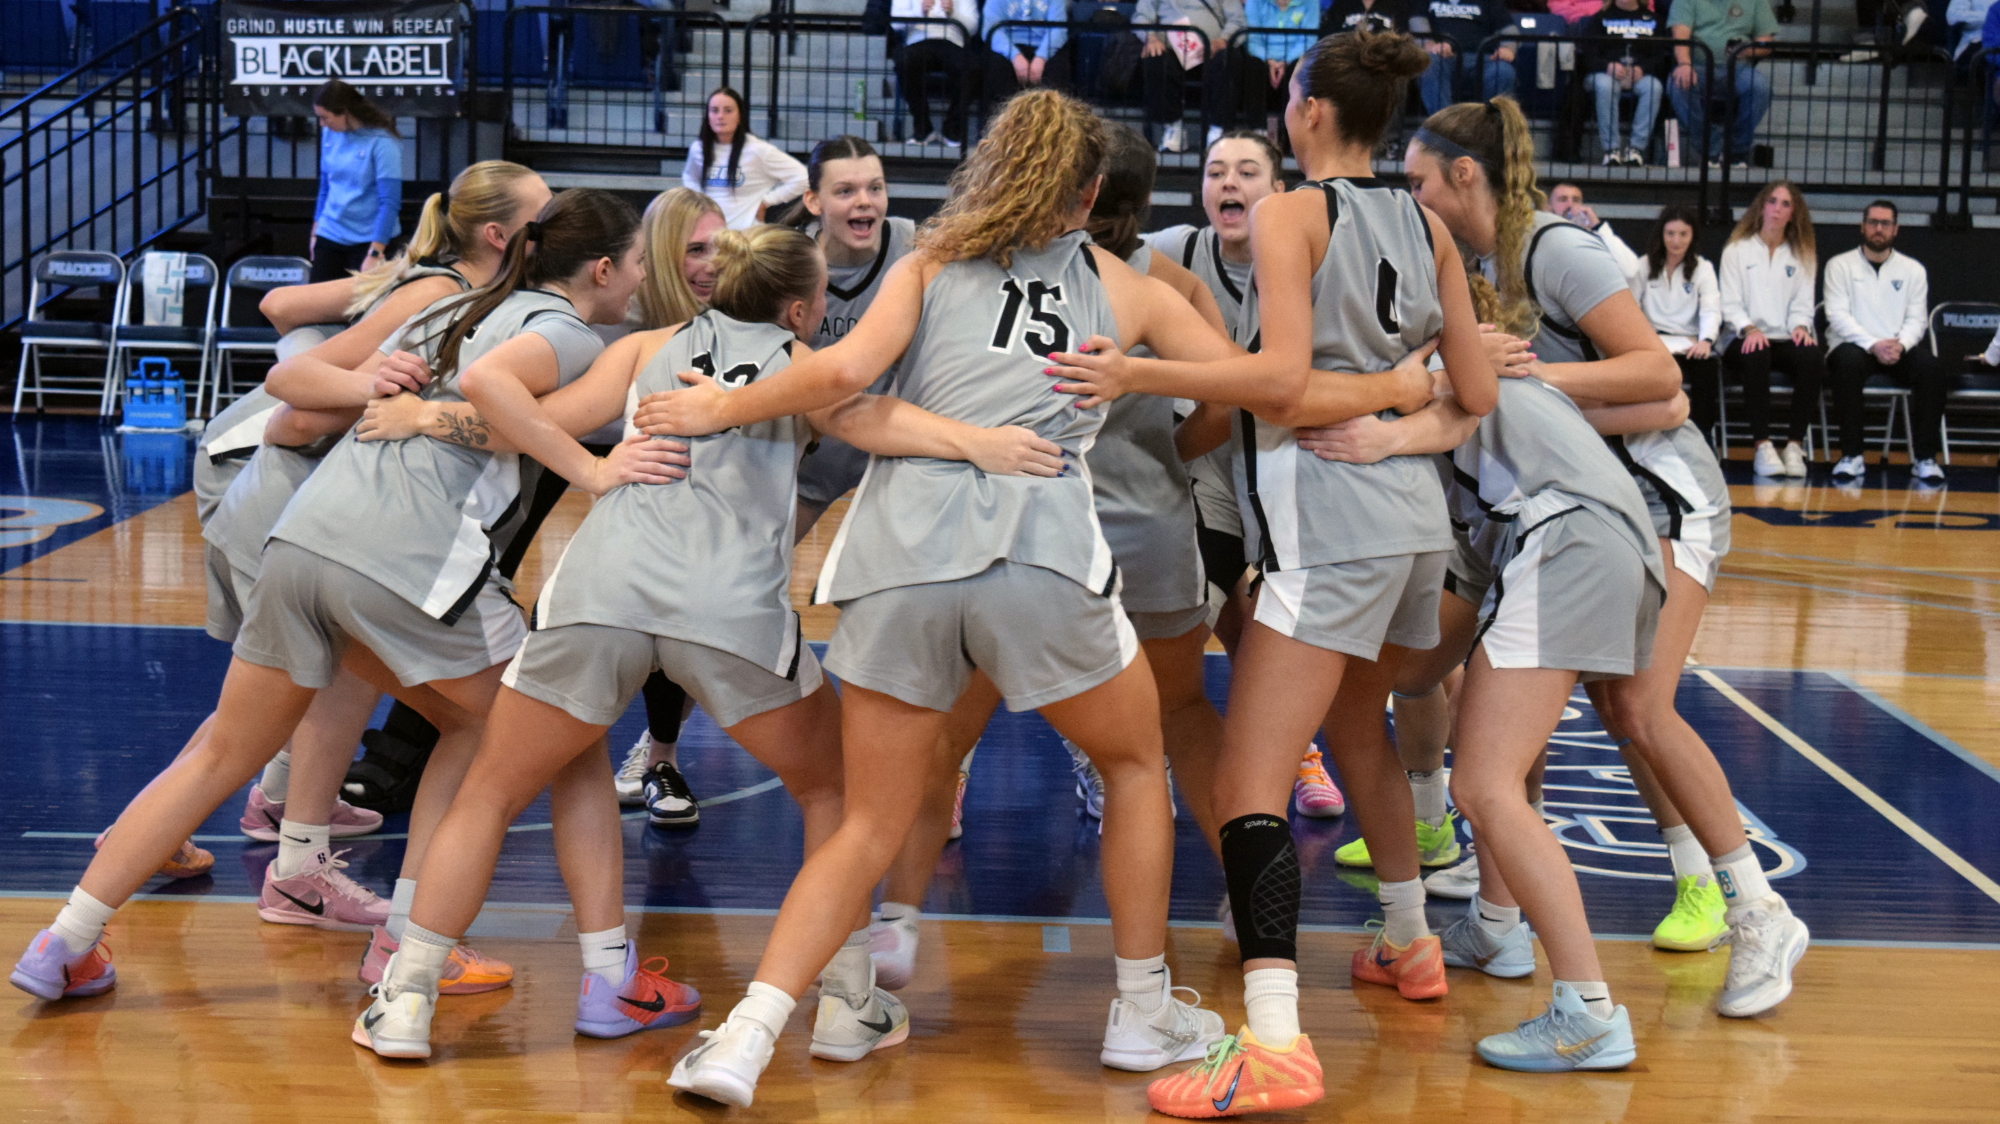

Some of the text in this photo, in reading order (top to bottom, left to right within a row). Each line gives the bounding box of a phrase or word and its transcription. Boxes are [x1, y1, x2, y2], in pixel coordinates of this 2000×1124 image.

[226, 18, 281, 34] GRIND.
[283, 18, 350, 34] HUSTLE.
[392, 18, 454, 34] REPEAT
[241, 85, 444, 97] SUPPMENTS
[987, 276, 1075, 362] 15
